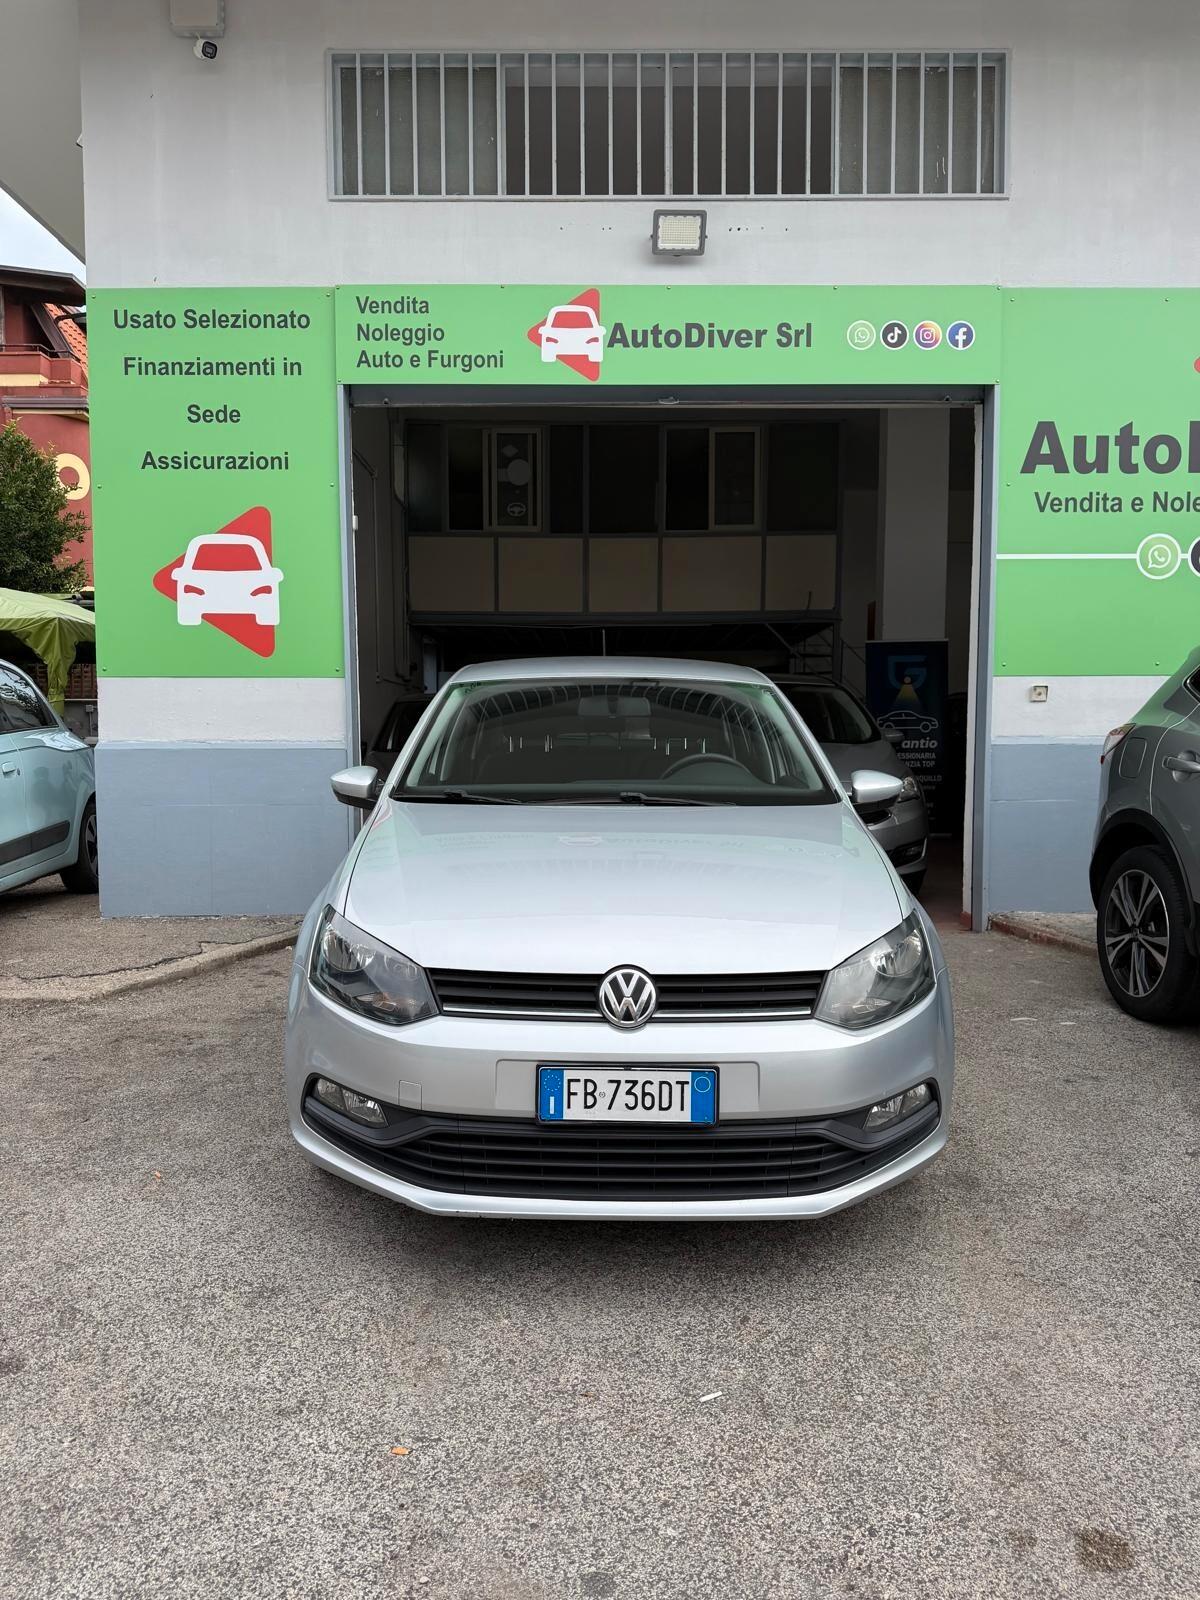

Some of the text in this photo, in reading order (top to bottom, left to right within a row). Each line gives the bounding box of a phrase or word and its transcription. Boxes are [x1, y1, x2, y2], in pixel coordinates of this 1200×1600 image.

[356, 295, 429, 314] Vendita
[113, 309, 310, 328] Usato Selezionato
[357, 323, 444, 345] Noleggio
[607, 322, 812, 348] AutoDiver Srl
[123, 357, 302, 376] Finanziamenti in
[357, 349, 504, 373] Auto e Furgoni
[187, 404, 241, 424] Sede
[1020, 421, 1200, 475] Auto
[141, 450, 289, 470] Assicurazioni
[1035, 492, 1123, 513] Vendita
[1131, 496, 1144, 513] e
[901, 737, 938, 749] antio
[896, 751, 936, 760] ESSIONARIA
